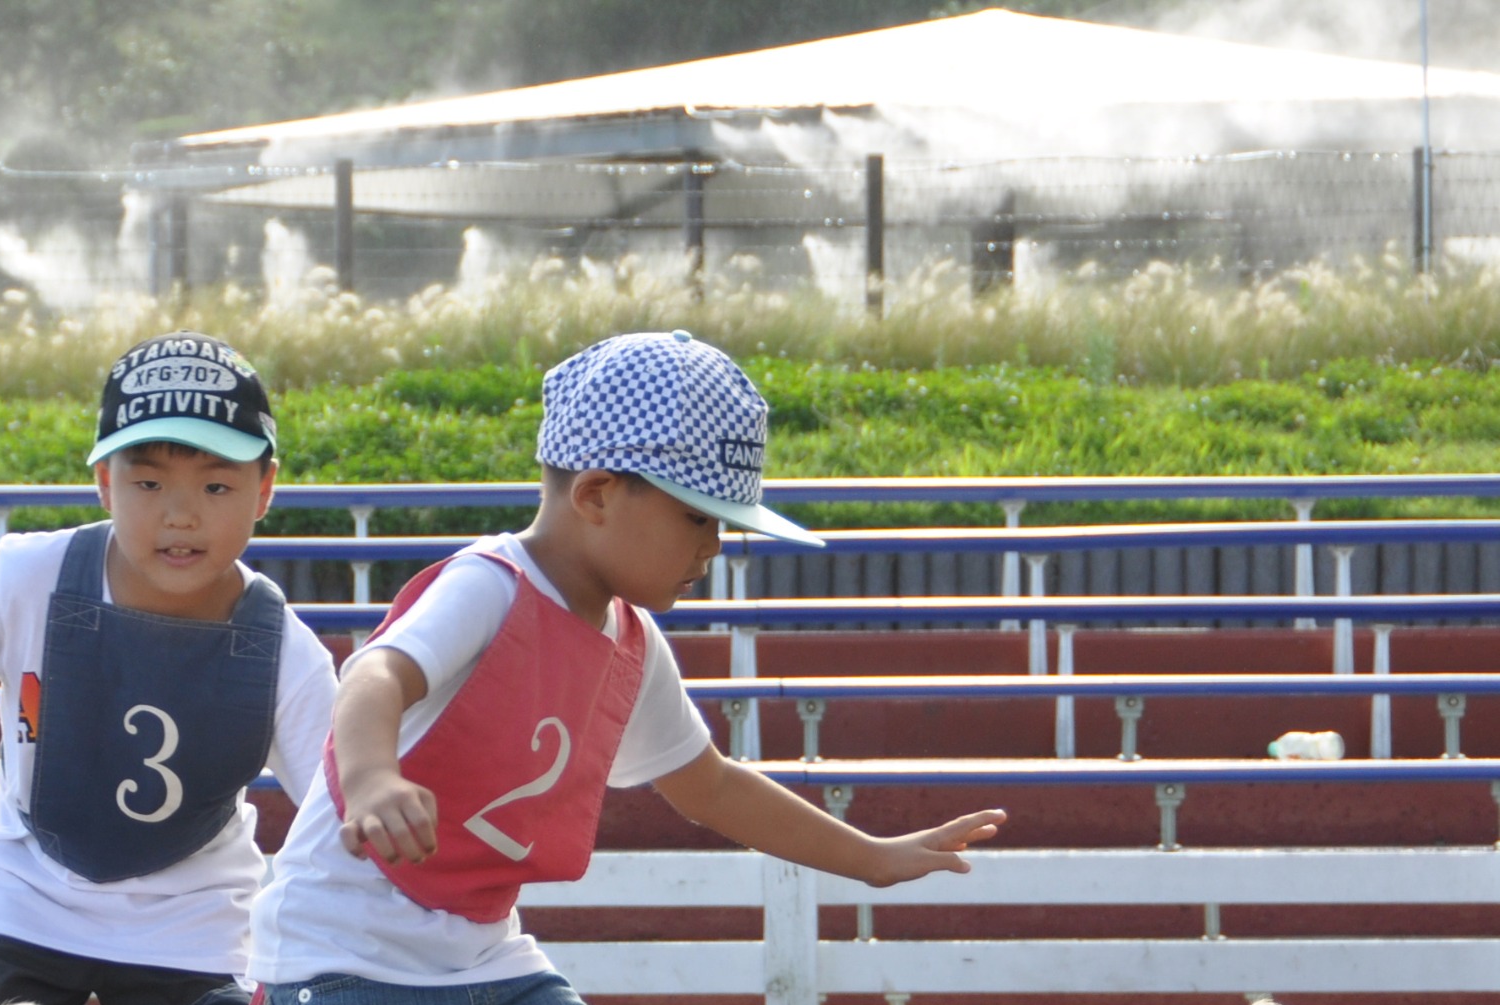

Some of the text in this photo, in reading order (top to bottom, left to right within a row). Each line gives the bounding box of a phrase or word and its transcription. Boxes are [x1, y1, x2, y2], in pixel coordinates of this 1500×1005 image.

[116, 391, 239, 428] ACTIVITY
[134, 365, 221, 387] XFG-707
[116, 704, 183, 823] 3
[463, 716, 571, 862] 2
